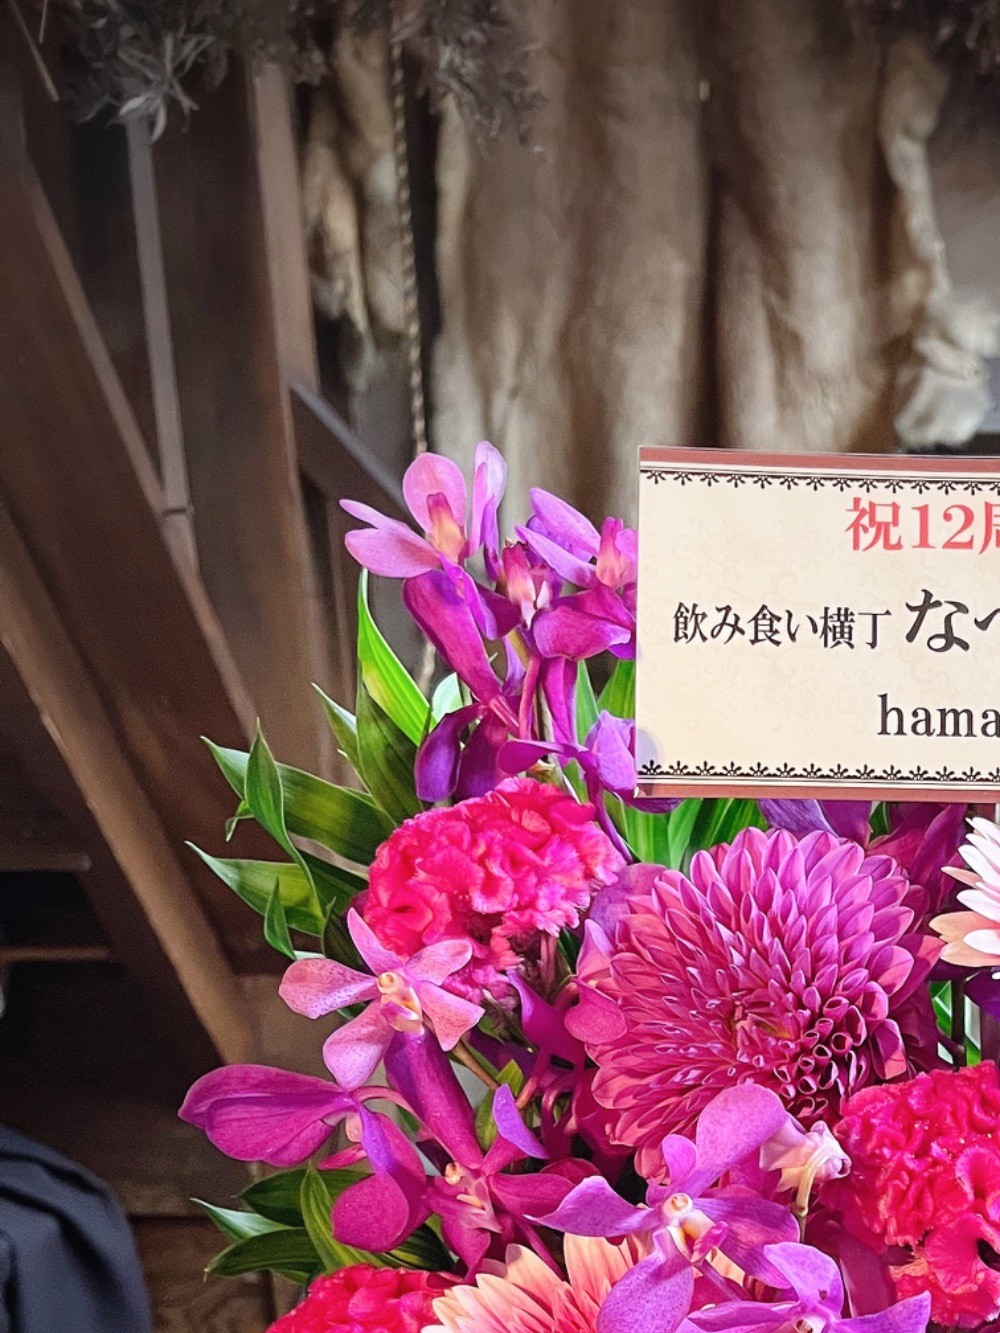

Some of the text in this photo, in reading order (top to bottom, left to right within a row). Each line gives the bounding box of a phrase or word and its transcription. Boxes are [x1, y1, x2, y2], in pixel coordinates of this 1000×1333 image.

[672, 601, 892, 650] 飲み食い横丁
